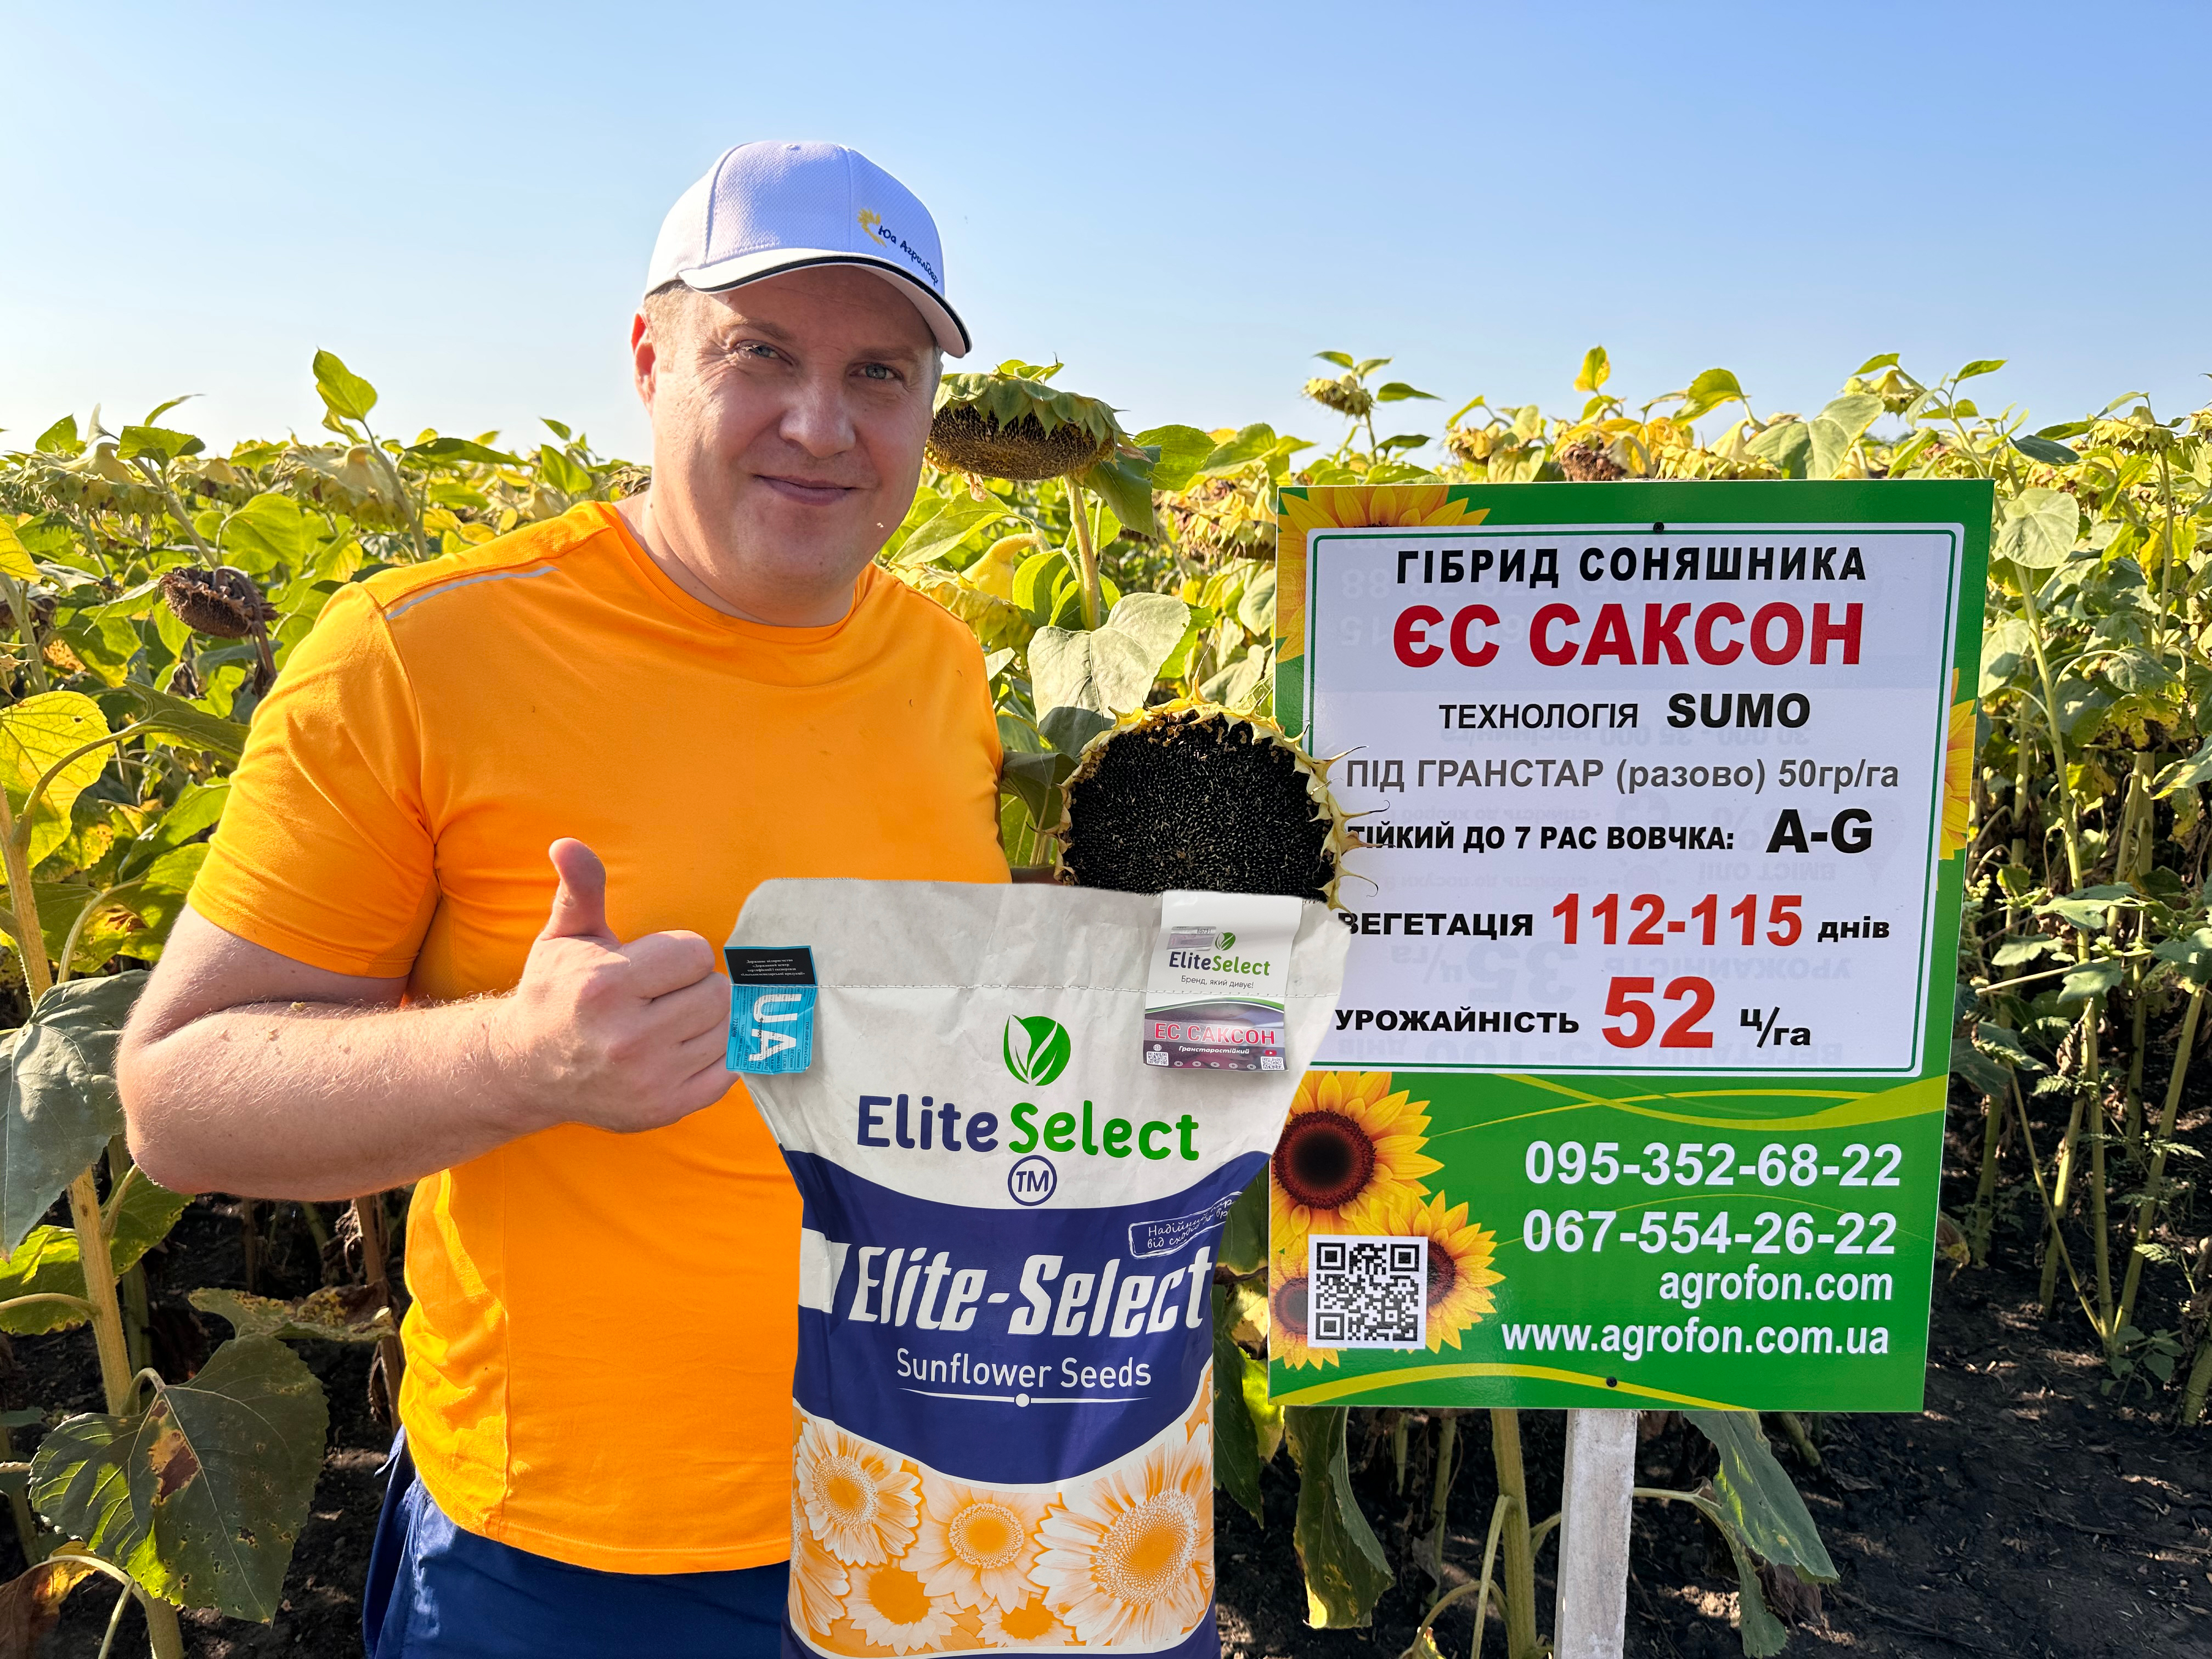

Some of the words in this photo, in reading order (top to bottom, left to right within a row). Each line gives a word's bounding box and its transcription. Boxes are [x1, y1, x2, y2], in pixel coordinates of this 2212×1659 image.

[1397, 549, 1559, 589] ГІБРИД
[1580, 547, 1866, 581] СОНЯШНИКА
[1394, 605, 1499, 667] ЄС
[1530, 602, 1863, 666] САКСОН
[1439, 704, 1638, 729] ТЕХНОЛОГІЯ
[1667, 693, 1810, 728] SUMO
[1347, 760, 1404, 792] ПІД
[1418, 759, 1603, 787] ГРАНСТАР
[1617, 759, 1765, 794] (разово)
[1779, 759, 1898, 794] 50гр/га
[1347, 822, 1454, 848] ТІЙКИЙ
[1463, 826, 1504, 853] ДО
[1515, 827, 1530, 849] 7
[1541, 827, 1596, 849] РАС
[1607, 827, 1733, 849] ВОВЧКА:
[1766, 809, 1872, 853] A-G
[1339, 913, 1532, 940] ВЕГЕТАЦІЯ
[1554, 893, 1802, 946] 112-115
[1818, 916, 1889, 942] днів
[1169, 951, 1270, 976] EliteSelect
[1181, 975, 1207, 985] Бренд,
[1229, 980, 1254, 989] дивує!
[749, 994, 802, 1062] UA
[1154, 1022, 1181, 1040] ЕС
[1187, 1025, 1276, 1045] САКСОН
[1335, 1007, 1578, 1032] УРОЖАЙНІСТЬ
[1602, 977, 1714, 1048] 52
[1740, 1007, 1810, 1048] ц/га
[1179, 1045, 1250, 1054] Гранстаростійкий
[1015, 1171, 1049, 1192] TM
[1526, 1141, 1901, 1186] 095-352-68-22
[1148, 1237, 1164, 1249] від
[1216, 1207, 1228, 1220] вр
[1524, 1210, 1896, 1254] 067-554-26-22
[848, 1246, 1211, 1338] Elite-Select
[1660, 1263, 1892, 1308] agrofon.com
[1502, 1317, 1888, 1361] www.agrofon.com.ua
[898, 1347, 1051, 1388] Sunflower
[1060, 1357, 1151, 1388] Seeds
